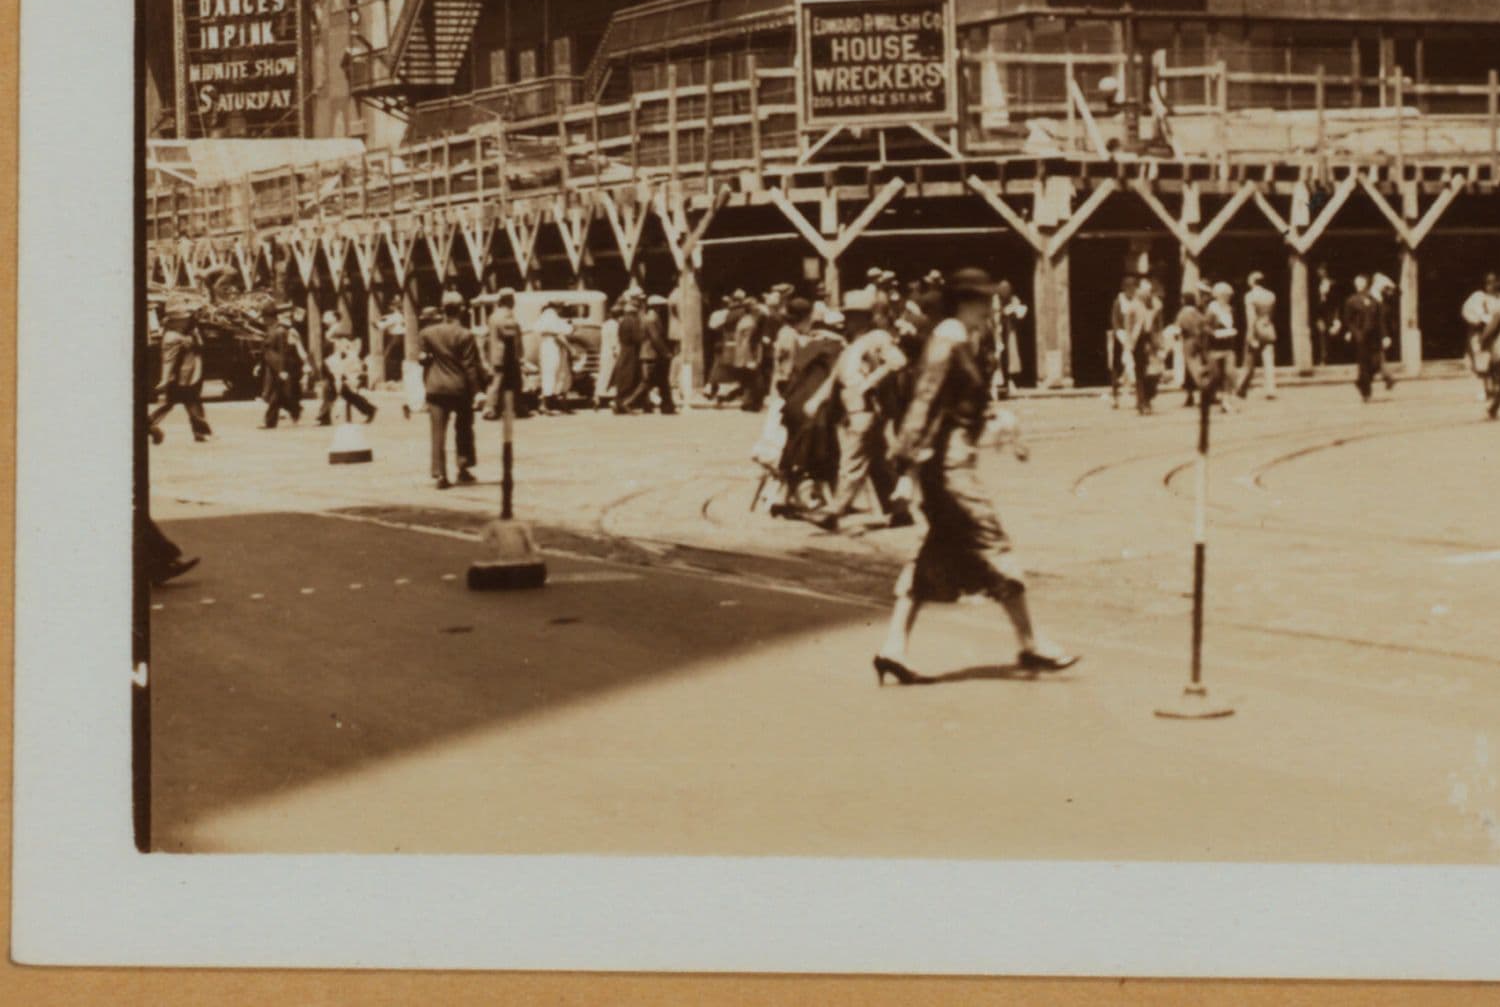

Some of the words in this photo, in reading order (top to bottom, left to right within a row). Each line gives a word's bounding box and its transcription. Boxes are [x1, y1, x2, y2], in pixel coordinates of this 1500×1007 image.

[223, 20, 274, 48] PINK
[831, 33, 920, 62] HOUSE
[189, 60, 249, 84] MIDNITE
[254, 56, 297, 77] SHOW
[814, 61, 943, 92] WRECKERS
[199, 83, 292, 114] SATURDAY
